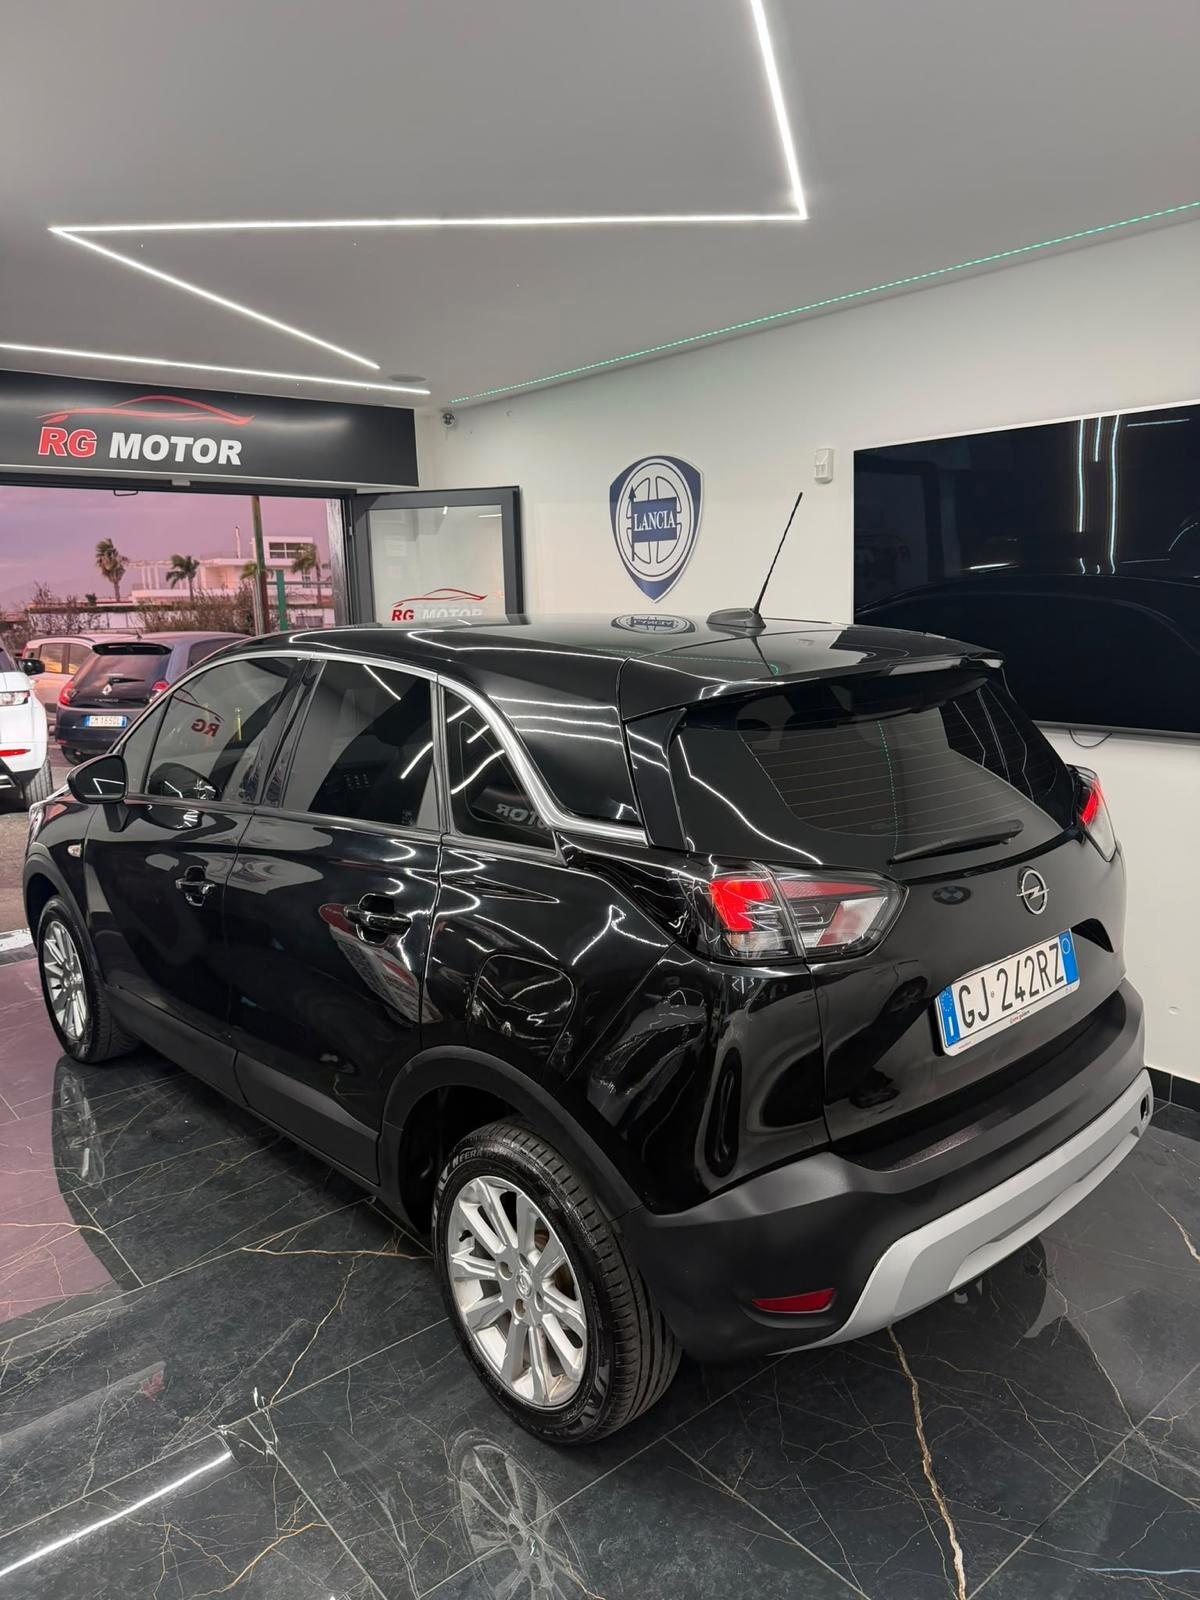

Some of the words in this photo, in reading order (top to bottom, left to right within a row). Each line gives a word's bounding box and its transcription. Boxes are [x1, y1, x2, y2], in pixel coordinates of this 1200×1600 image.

[37, 426, 98, 458] RG
[109, 431, 242, 465] MOTOR
[633, 510, 676, 532] LANCIA
[391, 608, 415, 621] RG
[958, 976, 990, 1029] GJ
[996, 942, 1064, 1012] 242RZ
